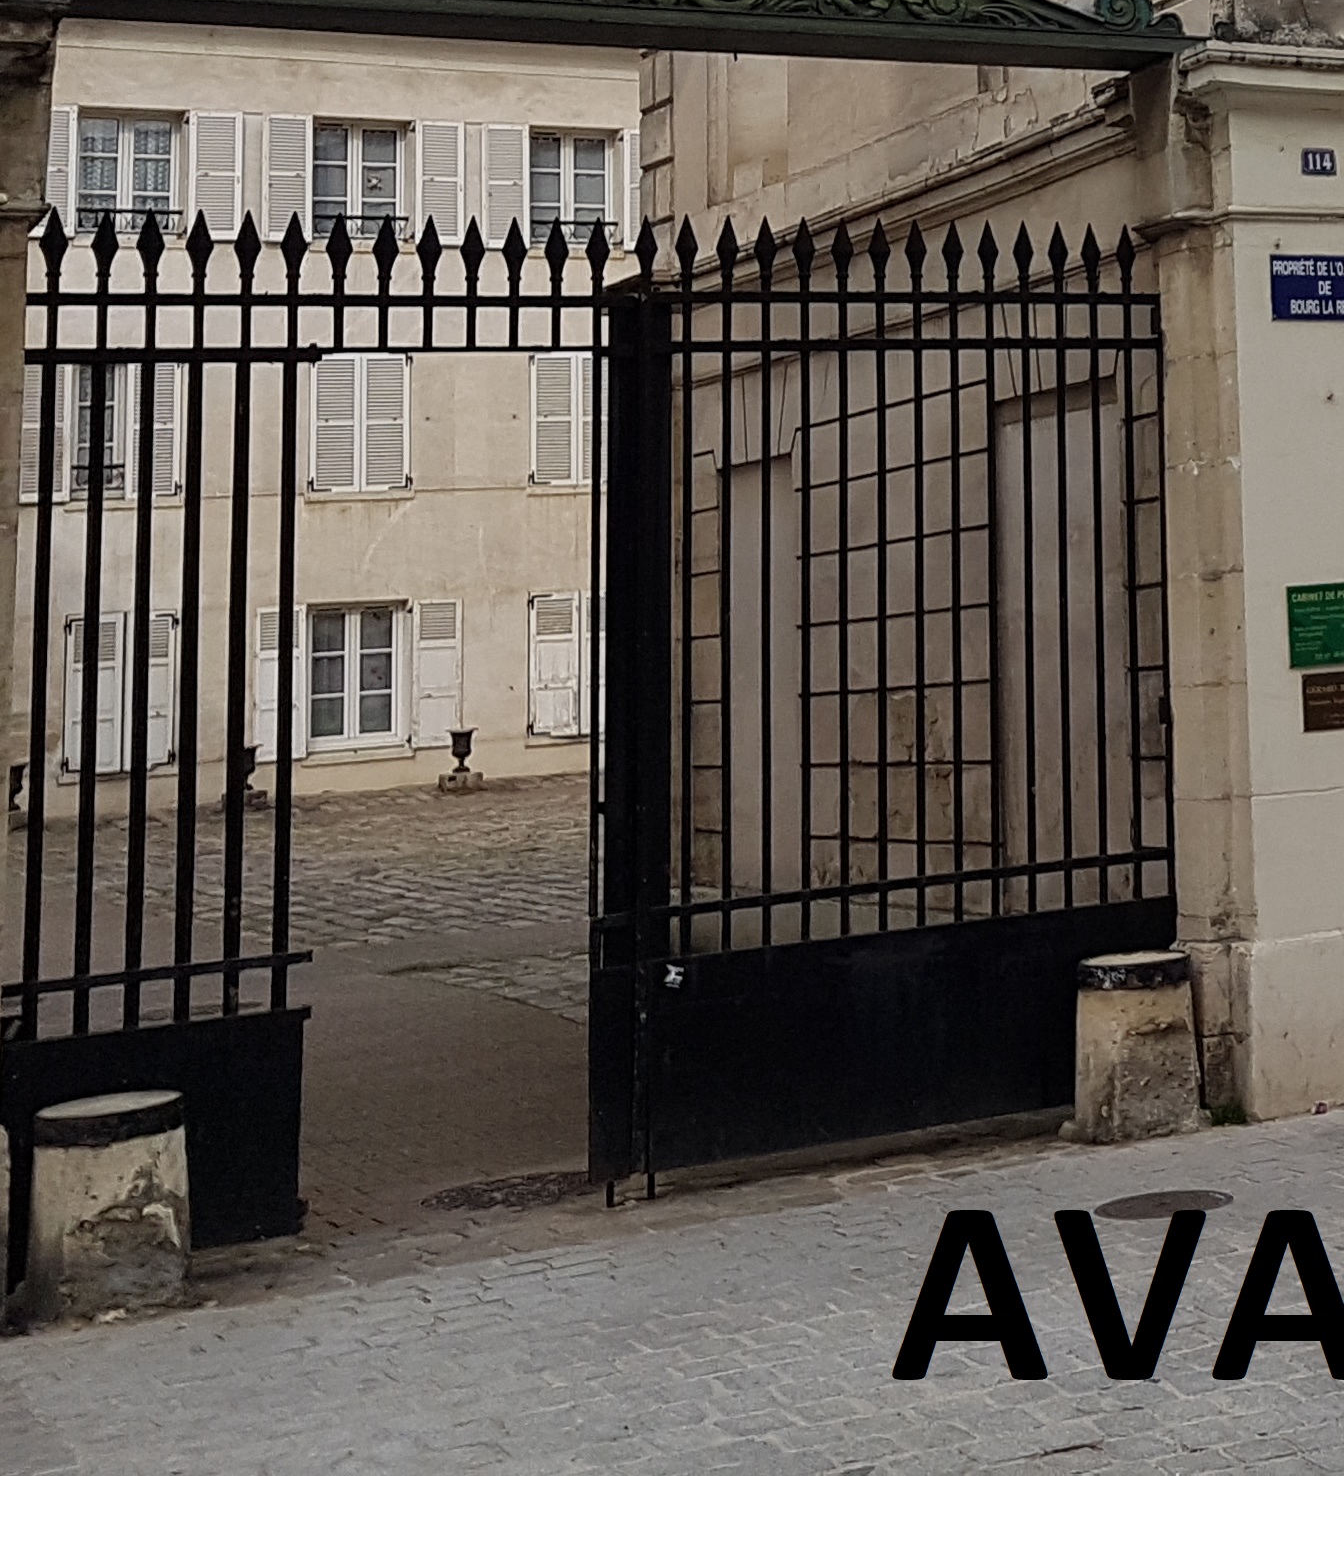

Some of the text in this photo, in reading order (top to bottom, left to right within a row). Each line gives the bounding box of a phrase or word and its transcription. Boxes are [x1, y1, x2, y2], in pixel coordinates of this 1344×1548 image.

[1308, 153, 1332, 170] 114
[1273, 258, 1315, 276] PROPRIÉTÉ
[1317, 261, 1328, 276] DE
[1318, 280, 1332, 295] DE
[1290, 300, 1320, 314] BOURG
[1322, 300, 1334, 314] LA
